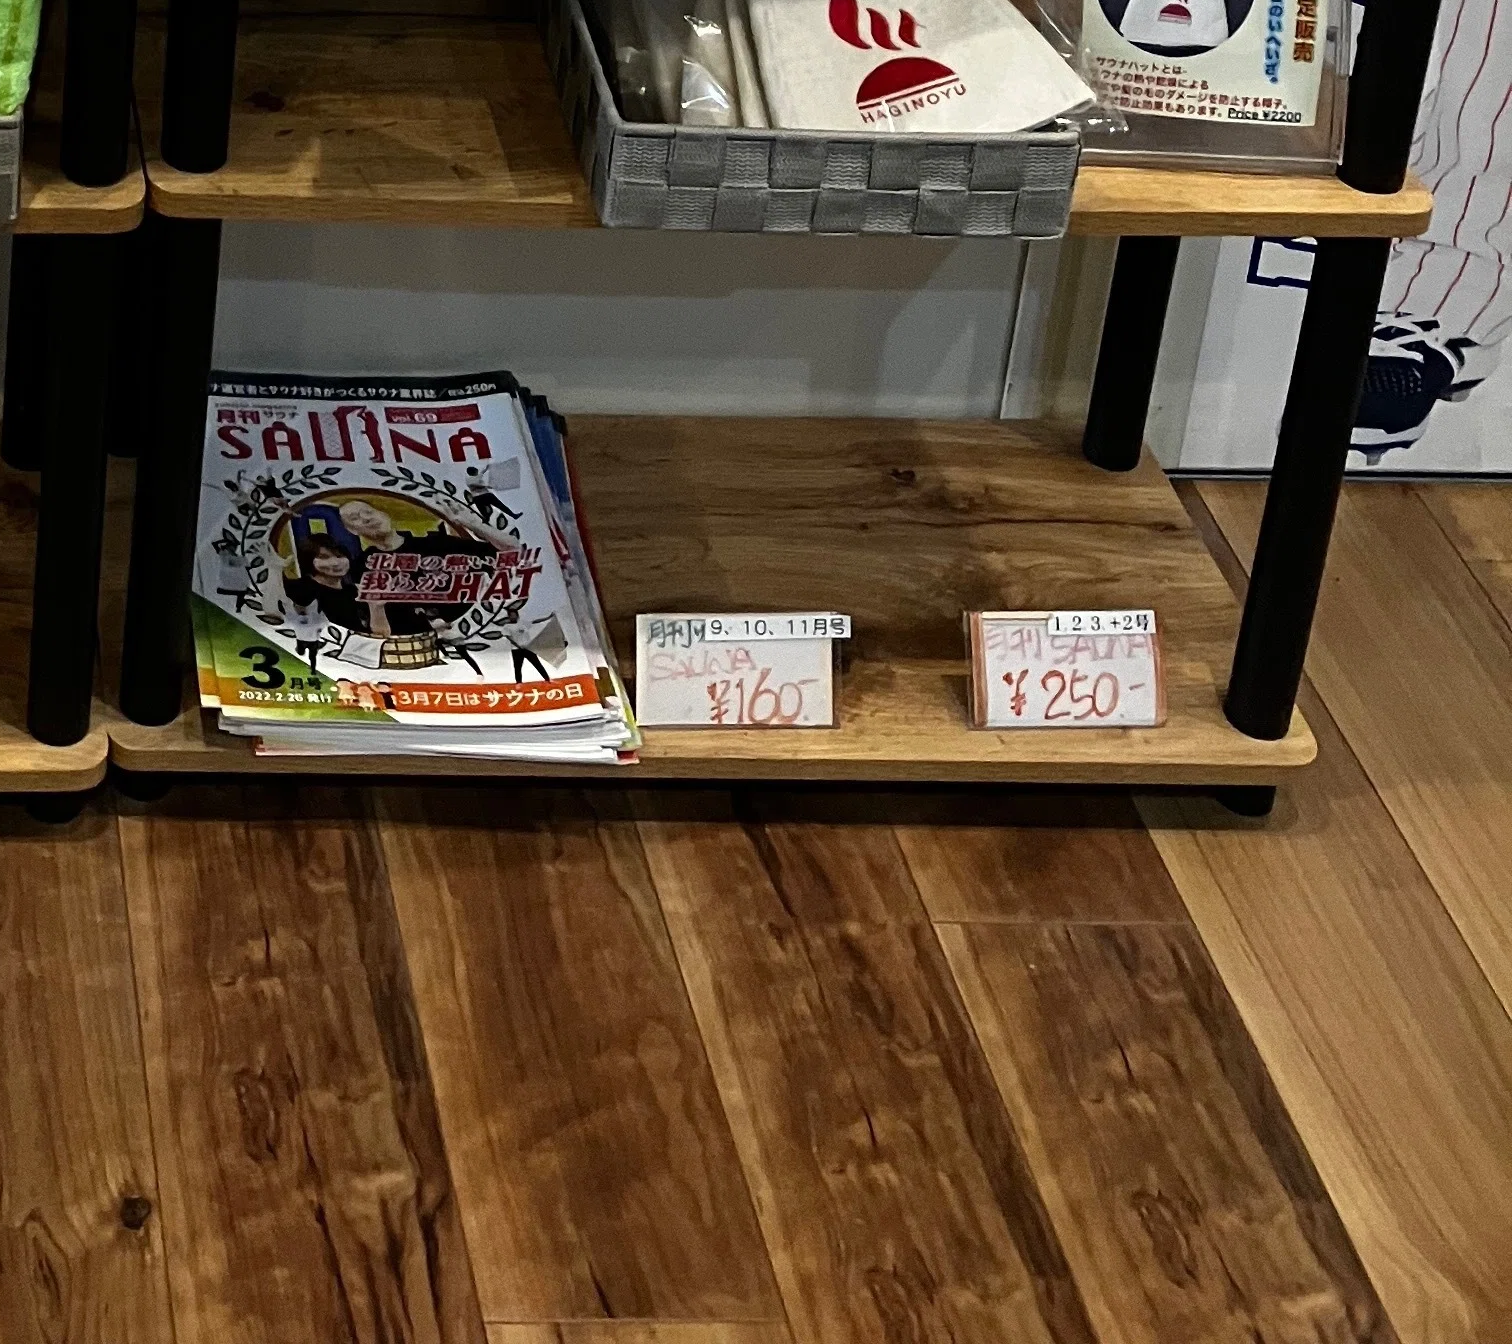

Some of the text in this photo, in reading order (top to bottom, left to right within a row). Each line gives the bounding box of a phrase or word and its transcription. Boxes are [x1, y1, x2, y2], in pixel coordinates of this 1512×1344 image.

[397, 683, 584, 707] 3月7日はサウナの日
